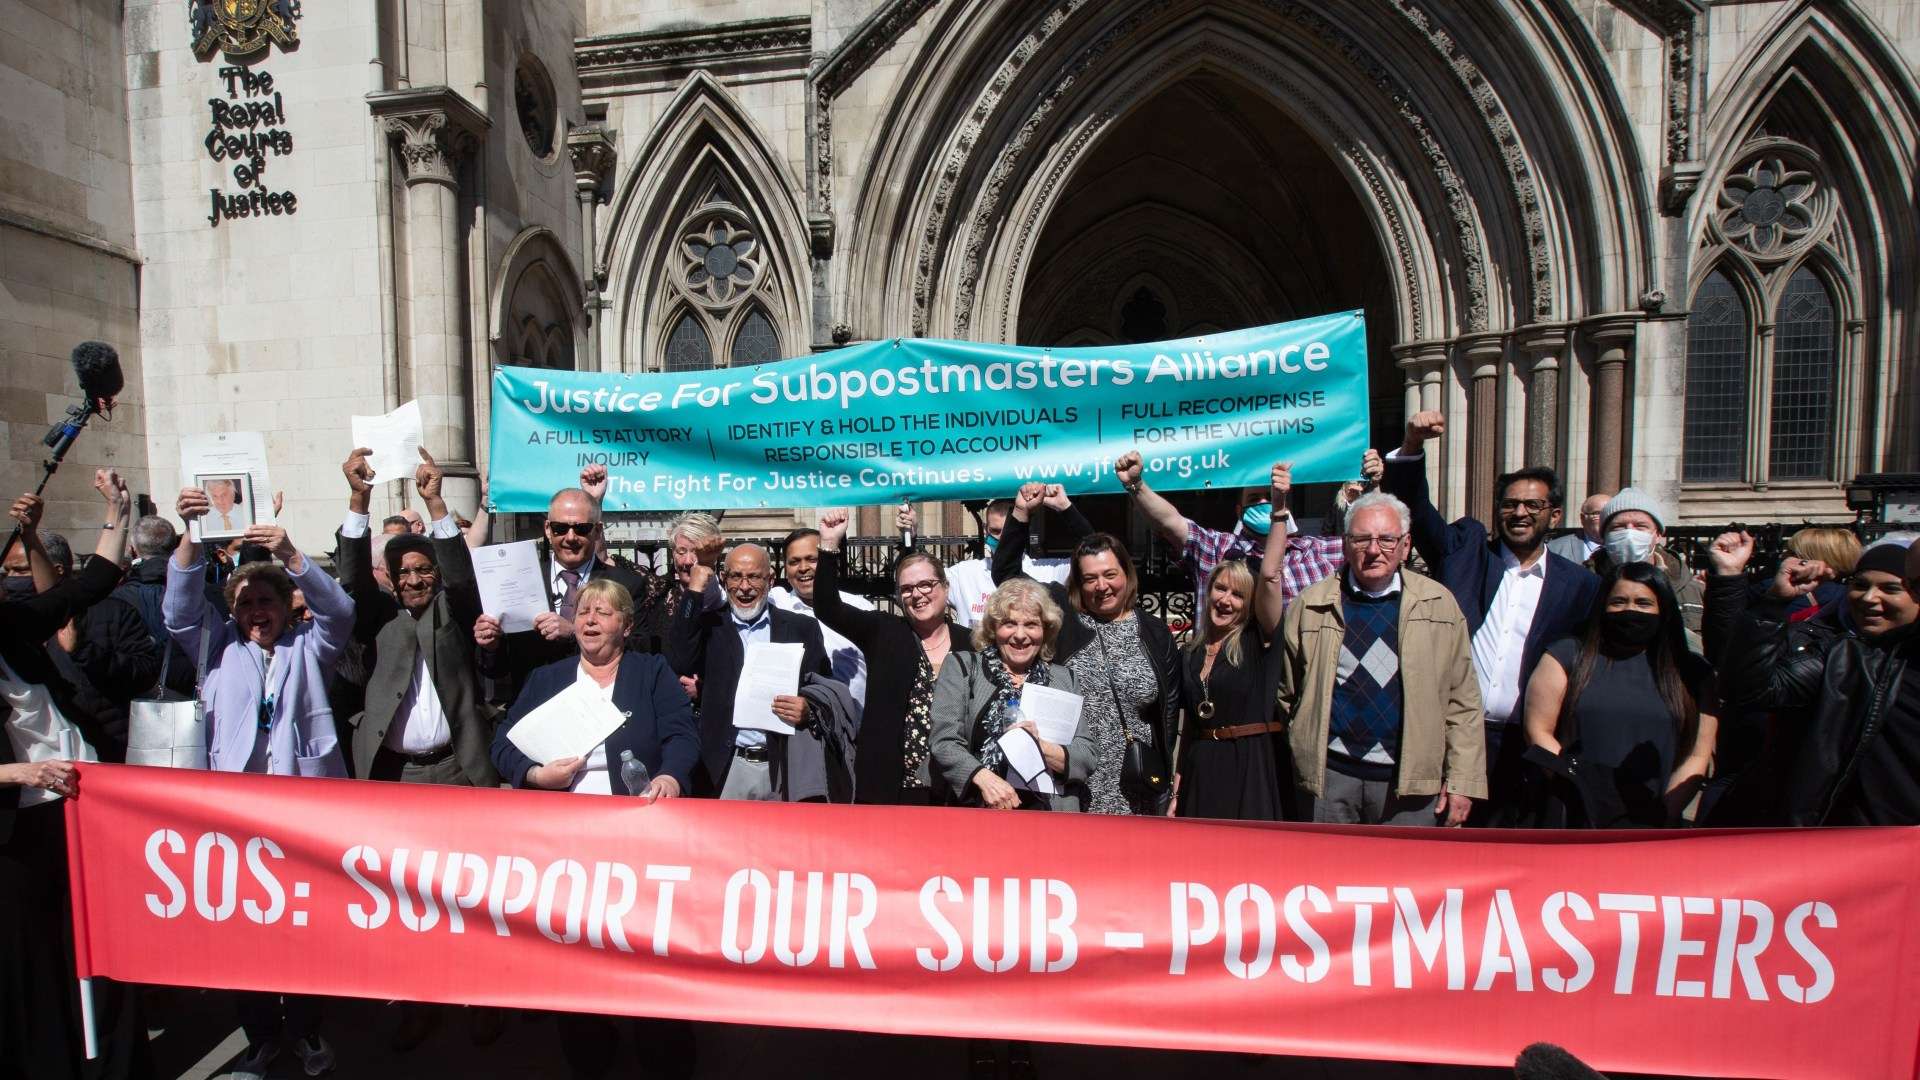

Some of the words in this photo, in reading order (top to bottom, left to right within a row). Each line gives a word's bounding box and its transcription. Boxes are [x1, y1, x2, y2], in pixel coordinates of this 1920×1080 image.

[219, 65, 273, 98] The
[208, 92, 285, 130] Royal
[205, 128, 292, 161] Courts
[234, 155, 265, 188] of
[208, 185, 296, 227] Justice
[523, 381, 662, 414] Justice
[671, 382, 743, 409] For
[750, 354, 1135, 408] Subpostmasters
[1145, 341, 1330, 384] Alliance
[1121, 402, 1173, 420] FULL
[1178, 391, 1325, 416] RECOMPENSE
[528, 431, 541, 445] A
[545, 430, 589, 445] FULL
[593, 427, 693, 444] STATUTORY
[728, 420, 815, 440] IDENTIFY
[820, 419, 834, 435] &
[839, 416, 896, 434] HOLD
[900, 413, 940, 431] THE
[945, 406, 1078, 429] INDIVIDUALS
[1133, 427, 1177, 444] FOR
[1181, 424, 1223, 441] THE
[1227, 417, 1315, 438] VICTIMS
[576, 451, 649, 467] INQUIRY
[764, 441, 902, 463] RESPONSIBLE
[908, 439, 935, 456] TO
[940, 434, 1042, 455] ACCOUNT
[606, 475, 646, 493] The
[653, 474, 711, 499] Fight
[718, 473, 757, 492] For
[764, 470, 851, 490] Justice
[859, 466, 992, 487] Continues.
[1014, 449, 1230, 482] www.jf.org.uk
[145, 828, 310, 927] SOS:
[342, 845, 691, 957] SUPPORT
[720, 868, 878, 970] OUR
[916, 875, 1079, 973] SUB
[1169, 882, 1838, 1005] POSTMASTERS
